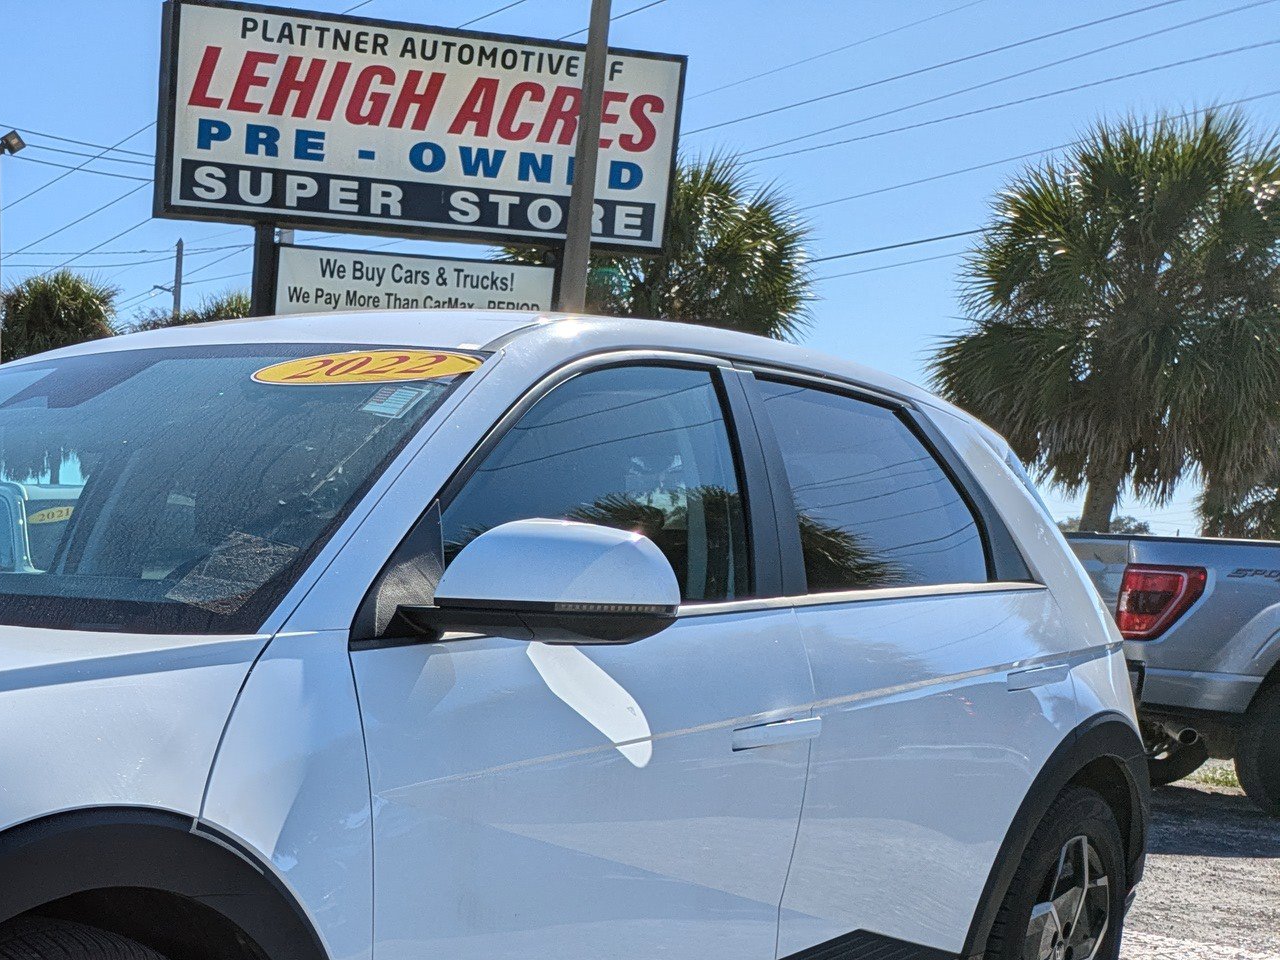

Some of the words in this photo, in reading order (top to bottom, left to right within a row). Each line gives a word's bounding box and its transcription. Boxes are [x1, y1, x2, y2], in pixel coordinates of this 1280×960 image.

[240, 16, 389, 57] PLATTNER
[398, 36, 580, 78] AUTOMOTIVE
[187, 45, 447, 131] LEHIGH
[446, 76, 665, 153] ACRES
[196, 117, 326, 162] PRE
[192, 165, 404, 217] SUPER
[319, 257, 347, 280] We
[352, 260, 386, 287] Buy
[391, 263, 431, 286] Cars
[435, 266, 448, 287] &
[453, 268, 515, 292] Trucks!
[288, 285, 311, 304] We
[314, 287, 341, 310] Pay
[345, 289, 380, 308] More
[384, 292, 420, 309] Than
[423, 295, 475, 310] CarMax
[280, 354, 448, 380] 2022
[38, 507, 71, 522] 2021
[1226, 567, 1280, 579] SPO
